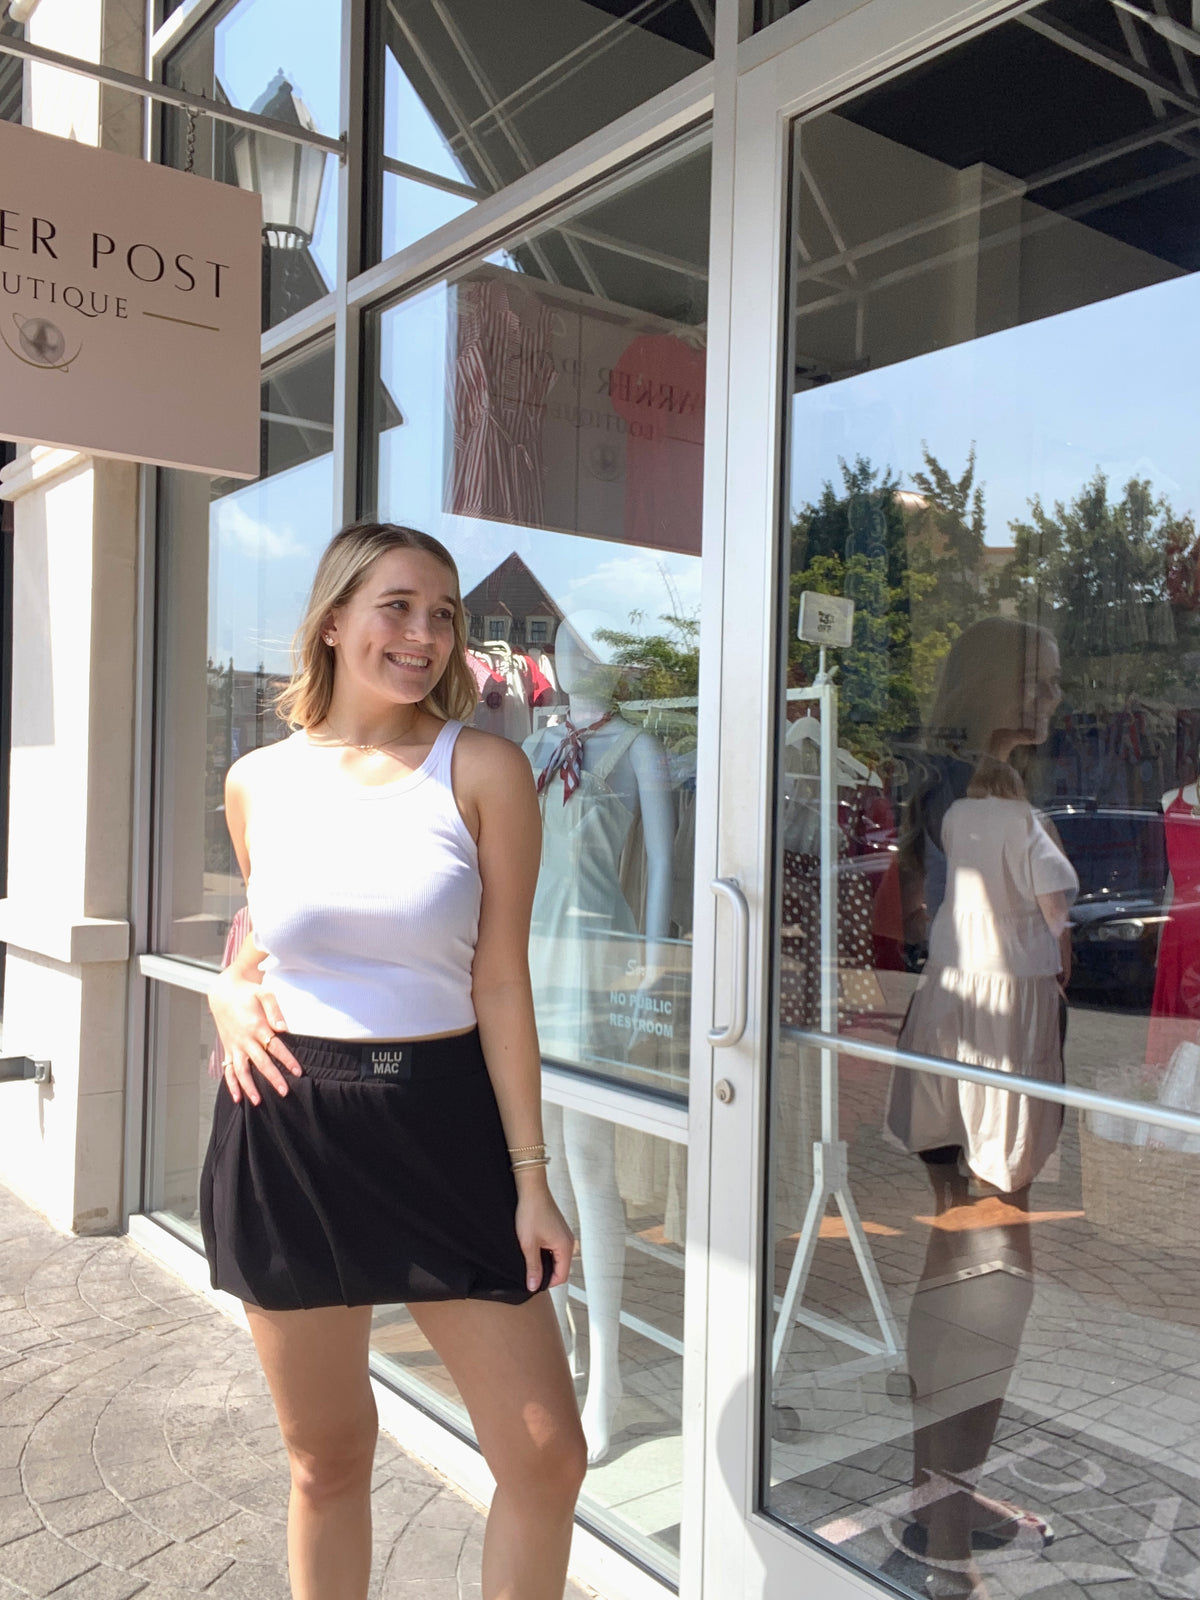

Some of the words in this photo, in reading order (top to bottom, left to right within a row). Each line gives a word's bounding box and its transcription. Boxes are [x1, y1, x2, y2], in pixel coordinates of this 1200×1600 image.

[0, 208, 58, 260] ER
[91, 232, 230, 298] POST
[2, 270, 128, 319] UTIQUE
[609, 990, 626, 1006] NO
[629, 994, 672, 1015] PUBLIC
[609, 1012, 674, 1038] RESTROOM
[371, 1051, 402, 1062] LULU
[373, 1063, 399, 1074] MAC
